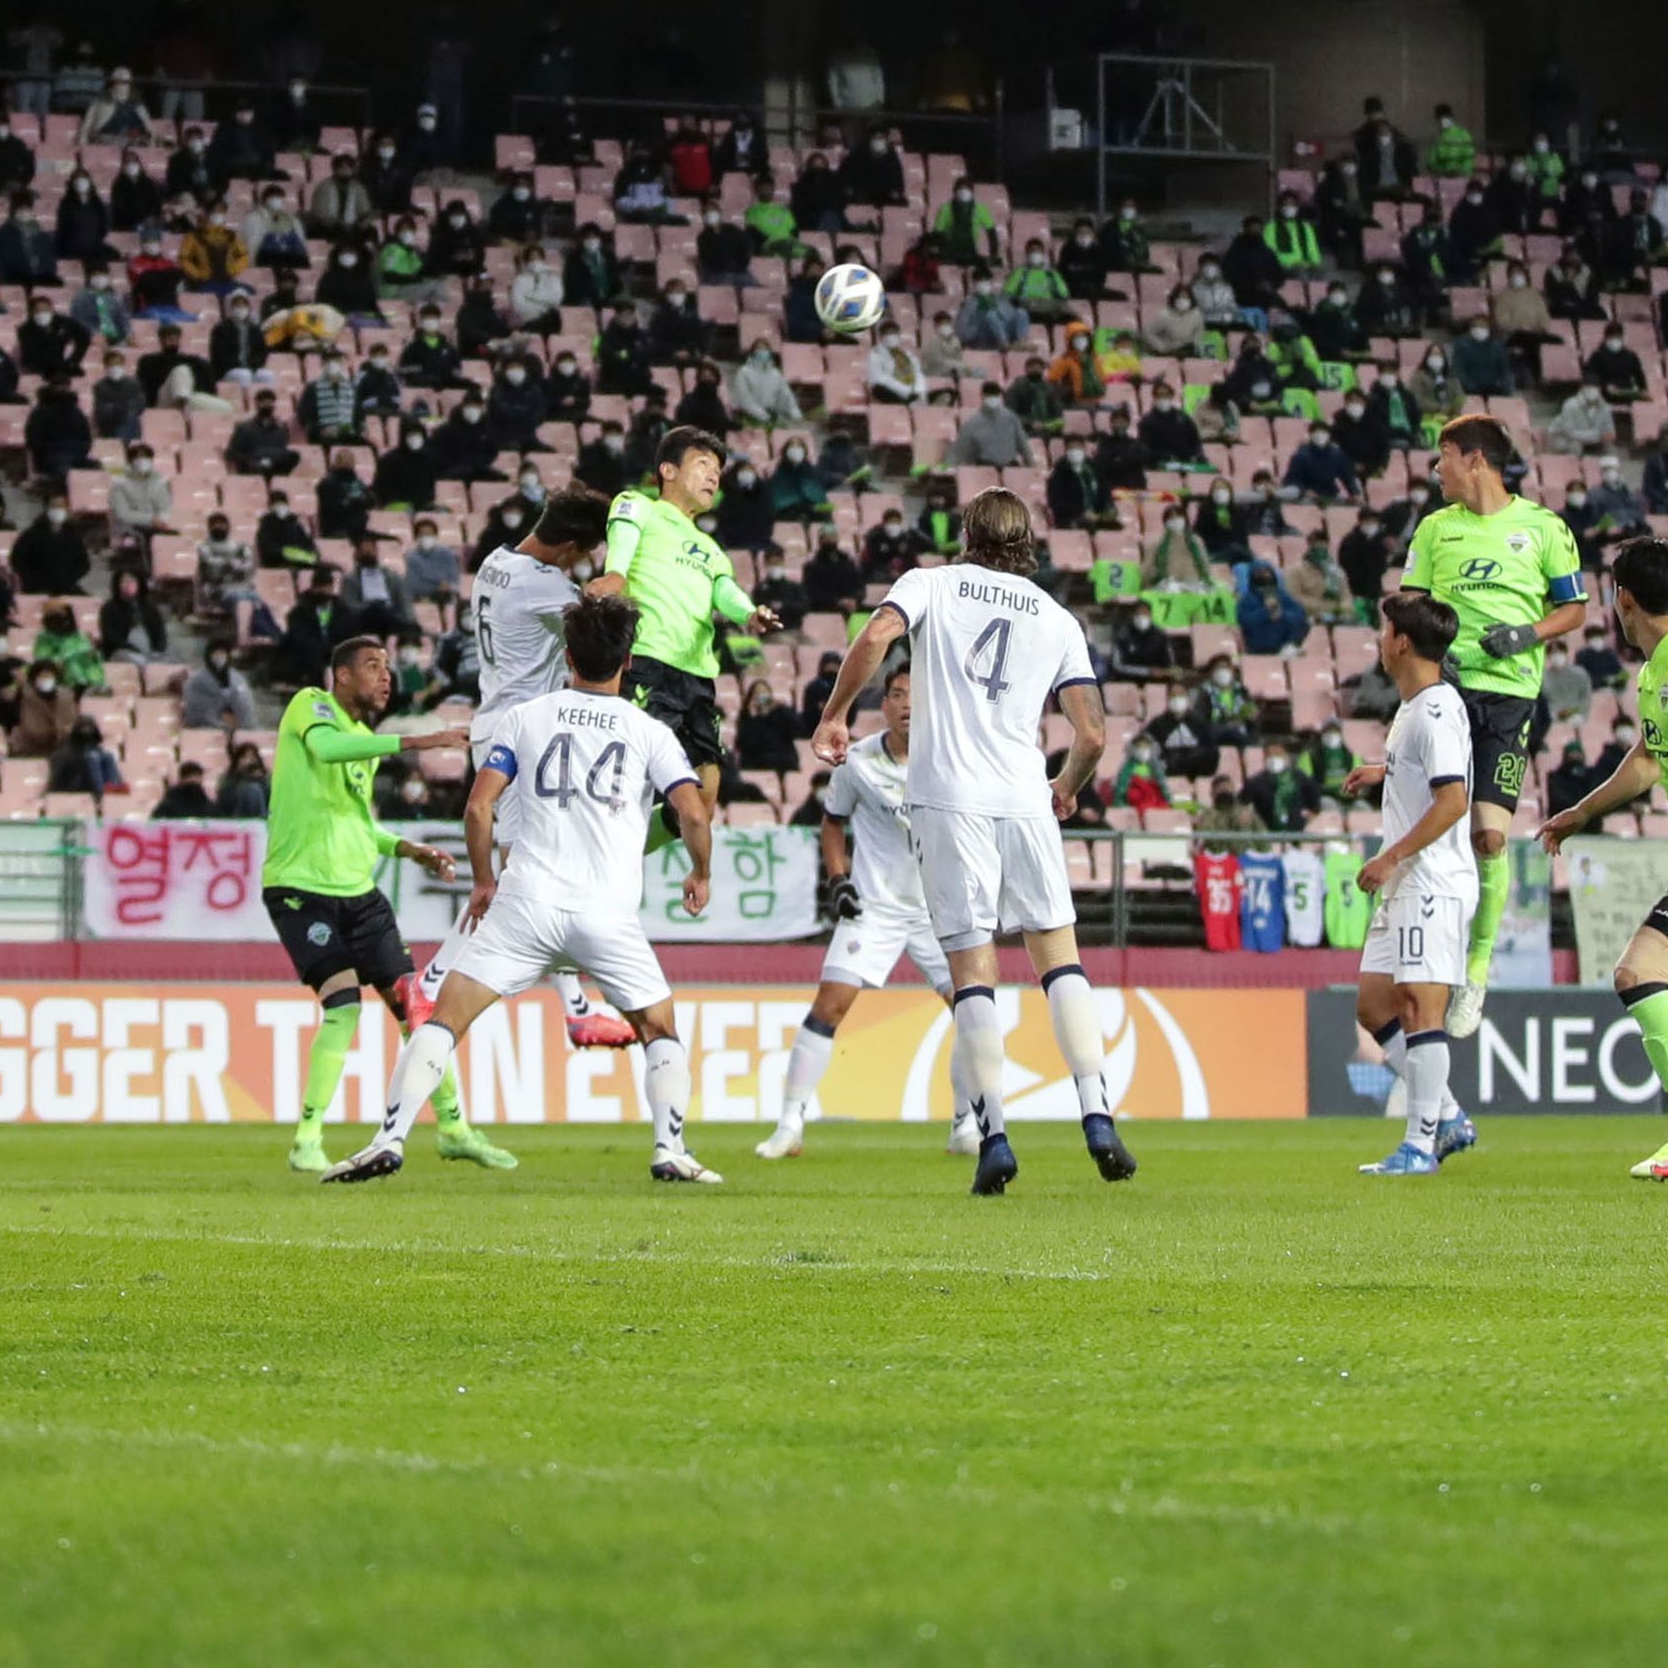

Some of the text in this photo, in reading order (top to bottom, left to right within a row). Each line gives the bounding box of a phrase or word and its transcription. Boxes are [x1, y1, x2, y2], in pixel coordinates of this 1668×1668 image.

[958, 580, 1040, 617] BULTHUIS
[964, 616, 1015, 706] 4
[557, 706, 619, 732] KEEHEE
[534, 732, 629, 818] 44
[107, 825, 251, 924] 열정
[1292, 882, 1309, 911] 5
[1399, 926, 1424, 958] 10
[254, 999, 546, 1124] THN
